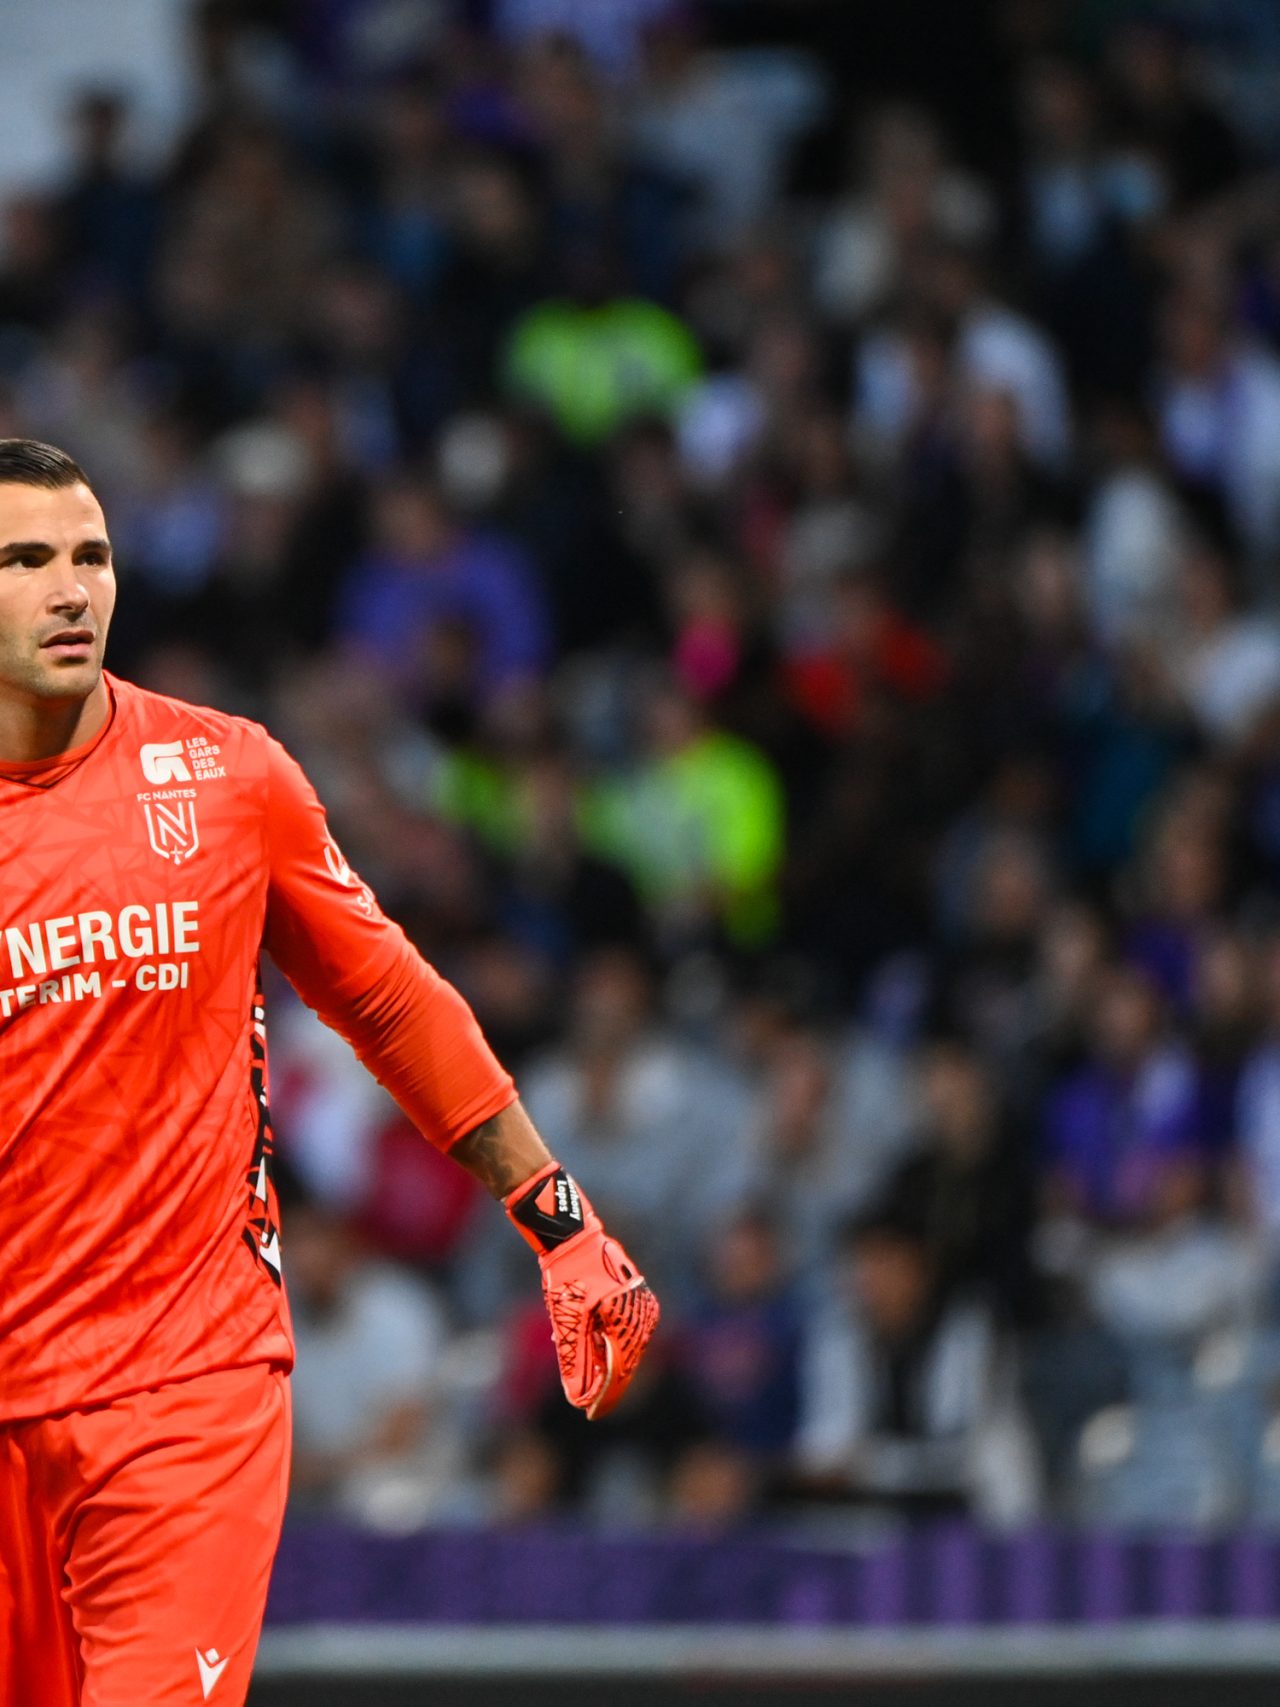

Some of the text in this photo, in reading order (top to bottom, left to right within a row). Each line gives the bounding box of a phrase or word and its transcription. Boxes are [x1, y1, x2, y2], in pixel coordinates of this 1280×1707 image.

[185, 737, 208, 749] LES
[189, 745, 220, 759] GARS
[192, 757, 216, 770] DES
[195, 766, 226, 781] EAUX
[137, 789, 197, 801] FC NANTES
[135, 962, 189, 992] CDI
[555, 1180, 569, 1212] Lopes
